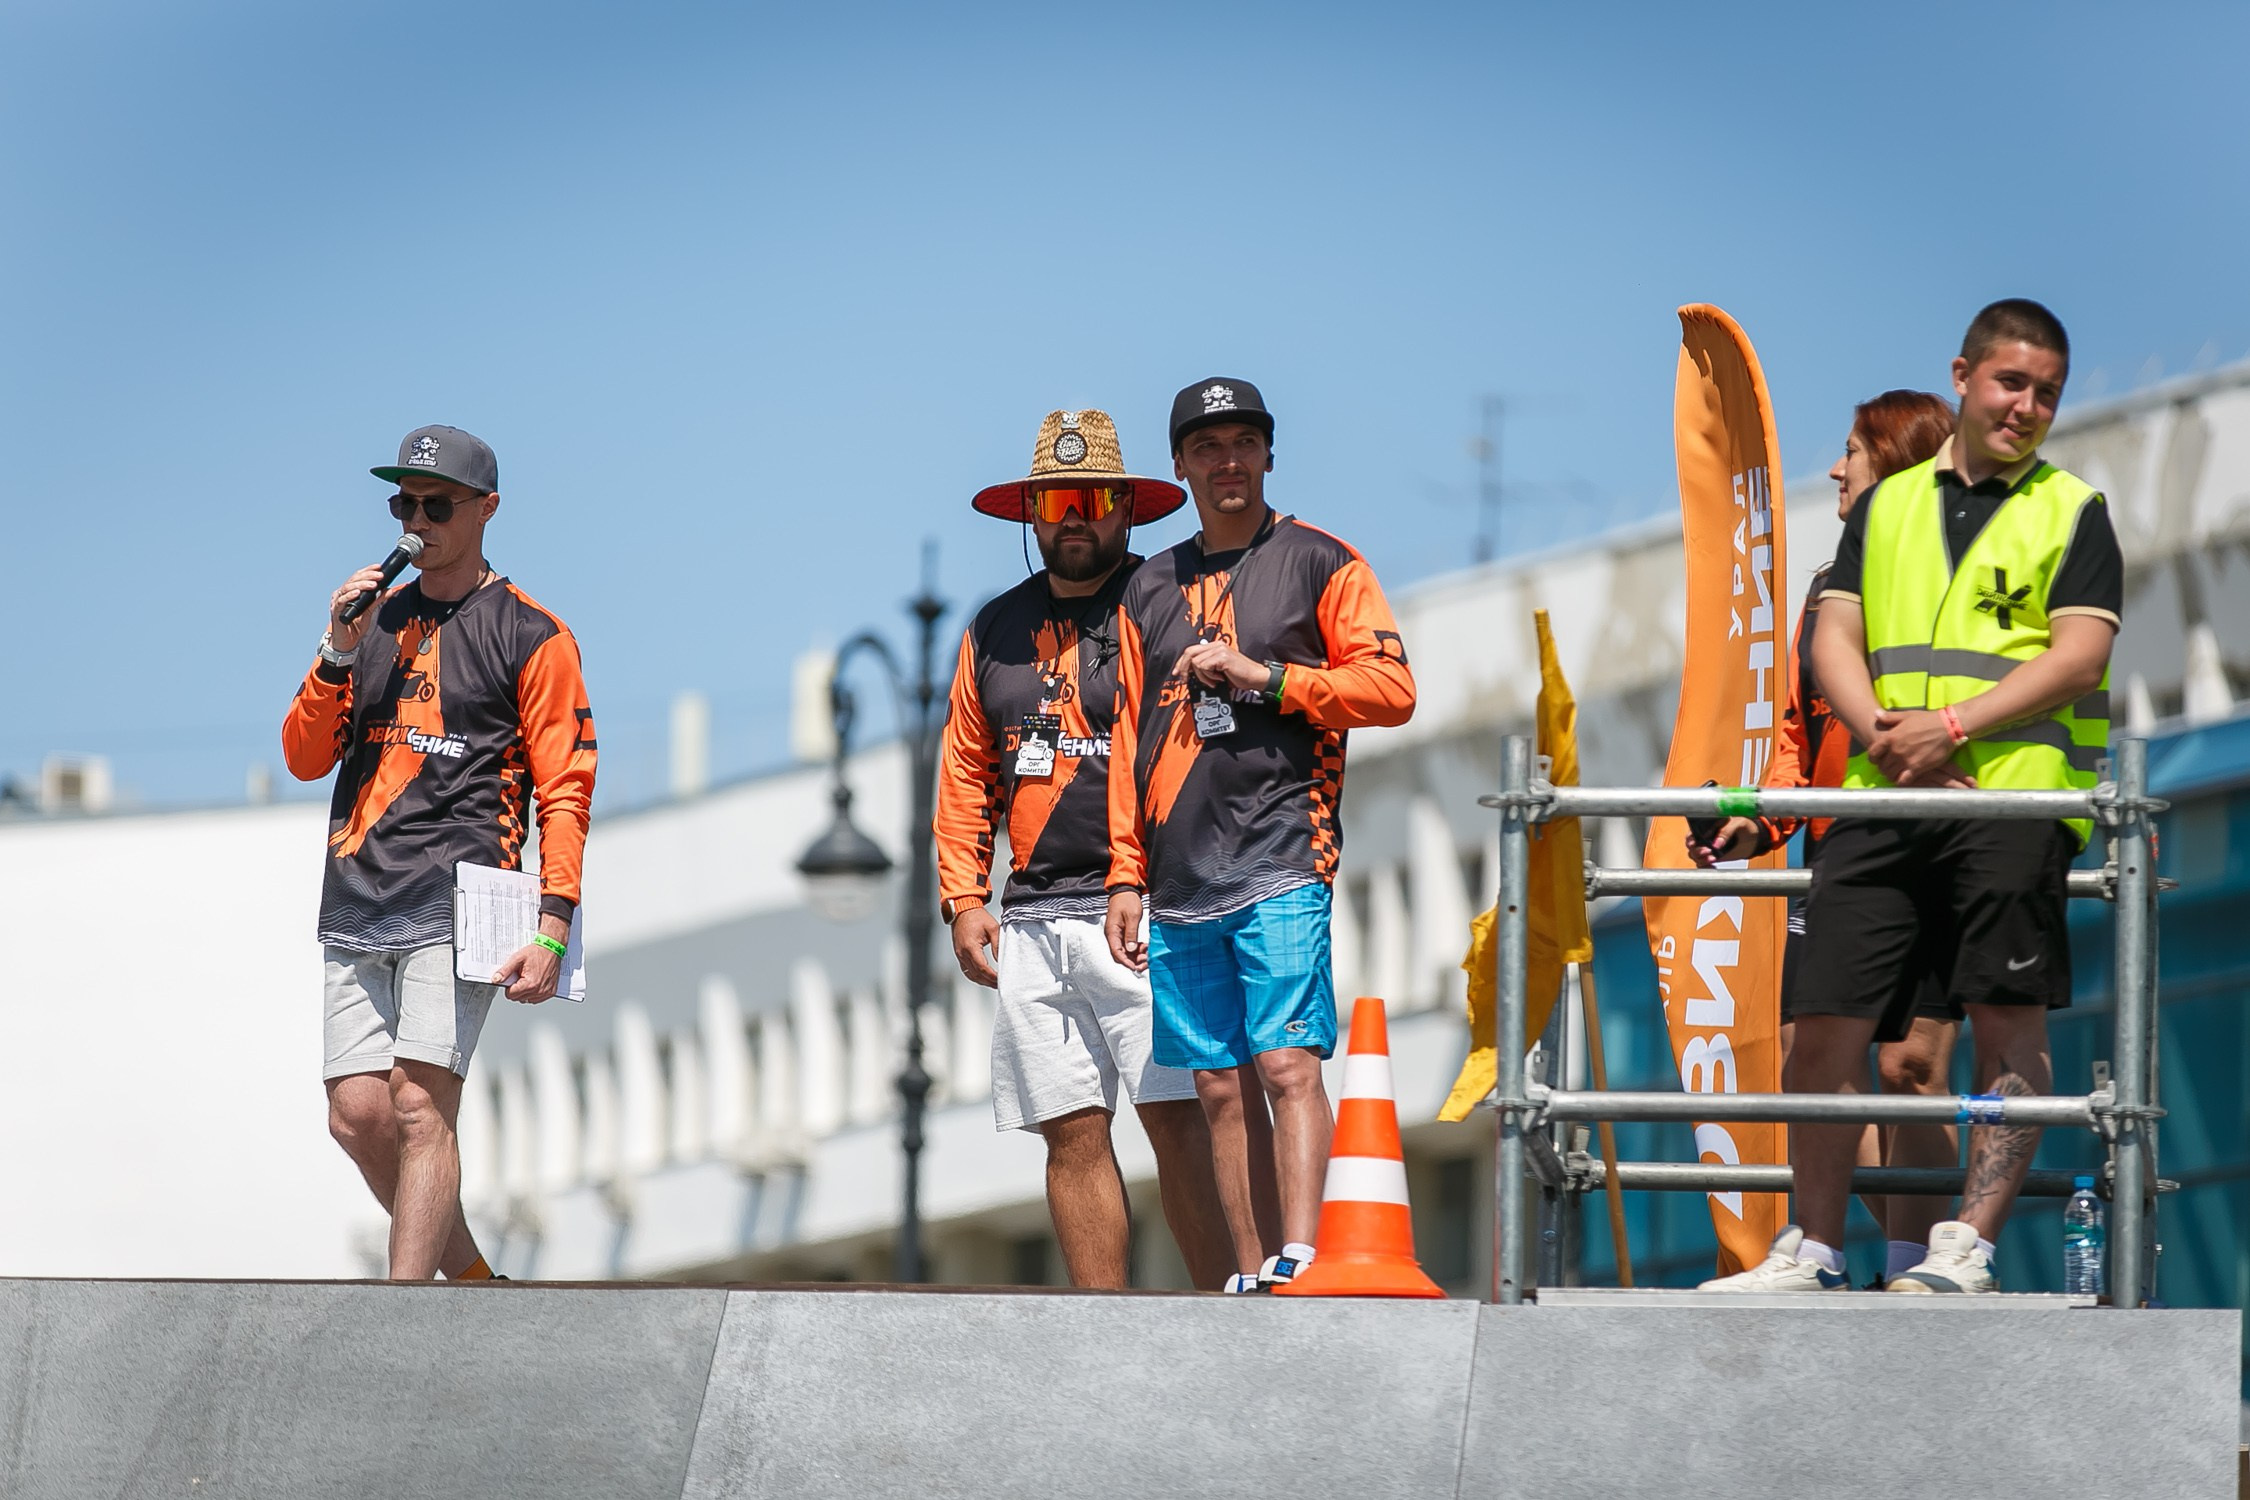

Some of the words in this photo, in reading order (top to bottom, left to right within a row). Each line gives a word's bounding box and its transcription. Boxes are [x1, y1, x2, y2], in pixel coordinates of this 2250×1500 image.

[1728, 472, 1747, 641] УРАЛ
[448, 733, 468, 741] УРАЛ
[1018, 767, 1048, 775] КОМИТЕТ
